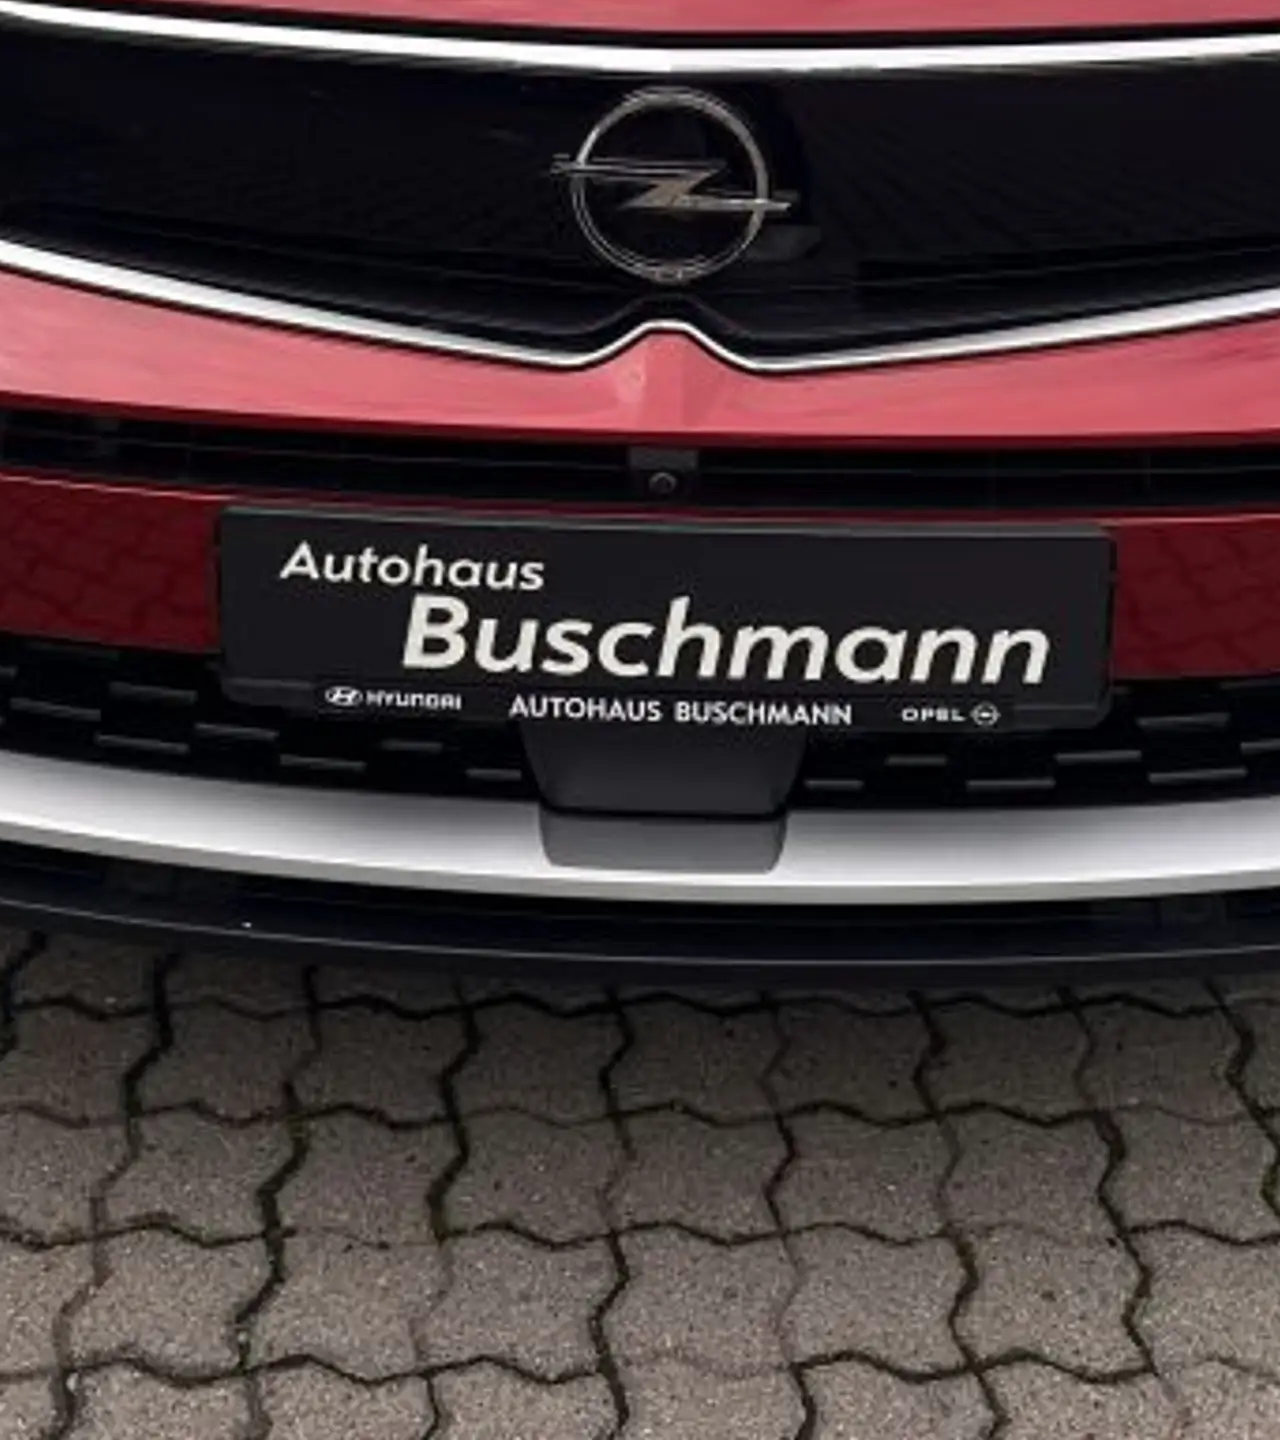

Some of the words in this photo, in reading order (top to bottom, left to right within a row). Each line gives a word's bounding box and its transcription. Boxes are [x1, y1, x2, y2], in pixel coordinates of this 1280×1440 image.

[279, 539, 545, 592] Autohaus
[401, 593, 1051, 685] Buschmann
[365, 688, 462, 711] HYUNDAI
[508, 693, 663, 723] AUTOHAUS
[673, 700, 853, 726] BUSCHMANN
[900, 706, 967, 723] OPEL
